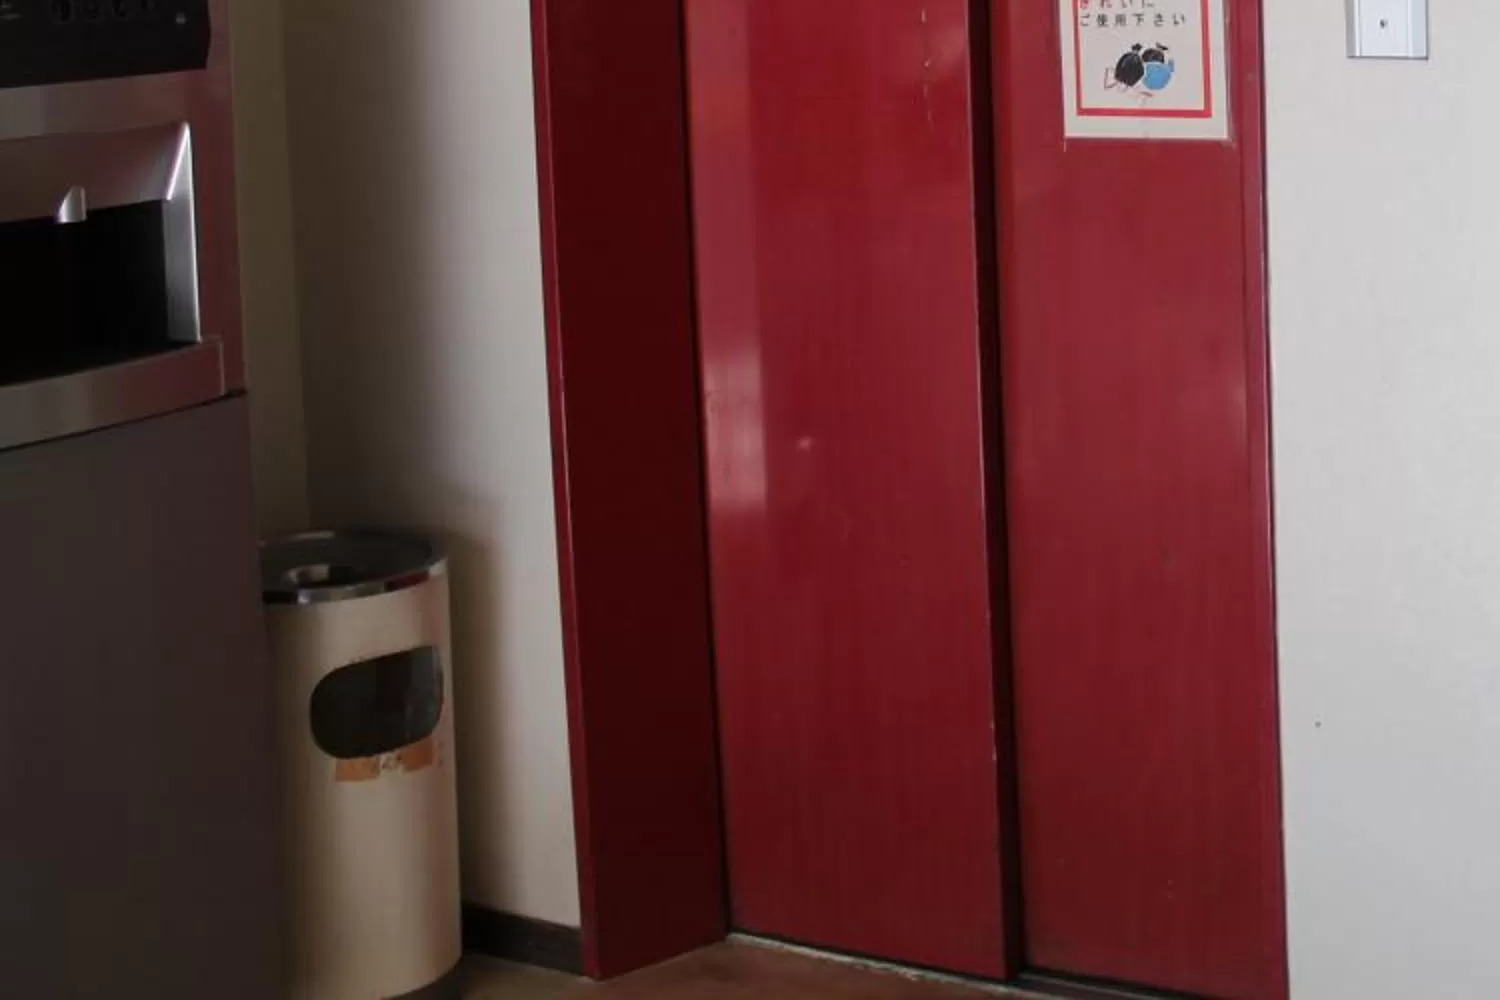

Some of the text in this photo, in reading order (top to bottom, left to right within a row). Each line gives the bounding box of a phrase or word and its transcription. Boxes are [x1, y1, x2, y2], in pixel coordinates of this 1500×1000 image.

[1080, 12, 1187, 27] ご使用下さい
